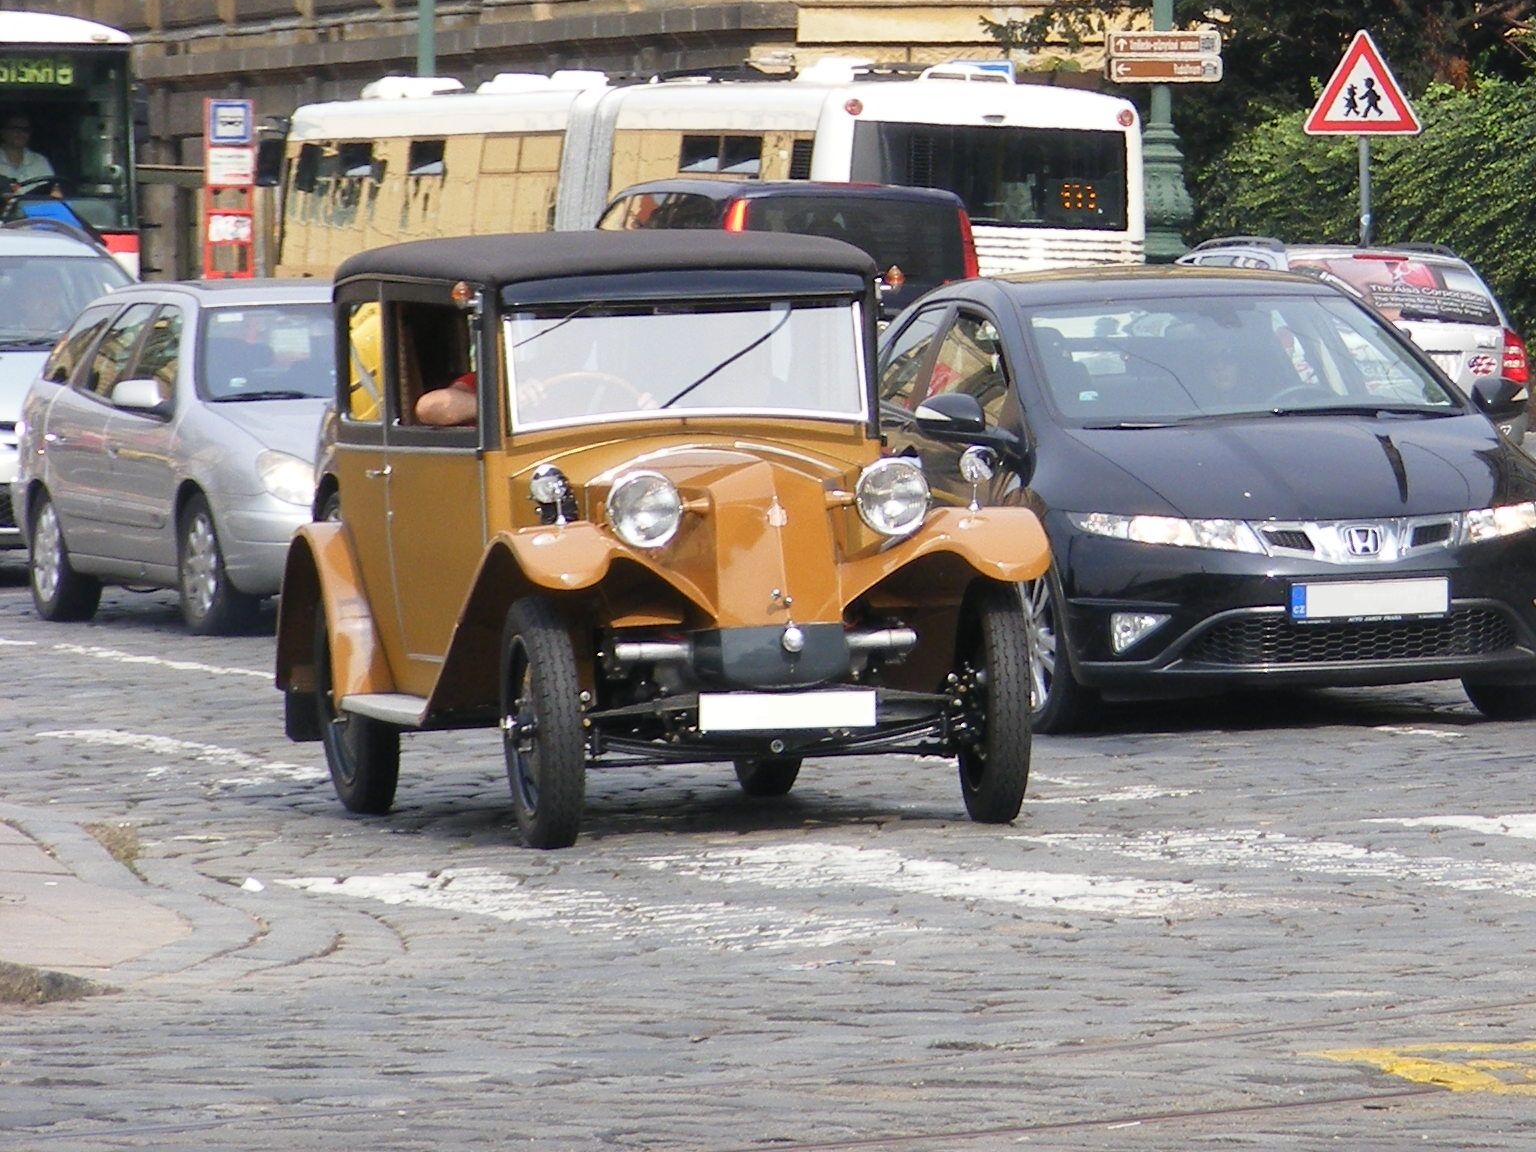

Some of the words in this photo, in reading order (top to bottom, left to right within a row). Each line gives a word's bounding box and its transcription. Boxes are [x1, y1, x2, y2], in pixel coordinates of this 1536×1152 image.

[1370, 285, 1392, 293] The
[1422, 287, 1488, 303] Corporation
[1292, 605, 1306, 615] CZ
